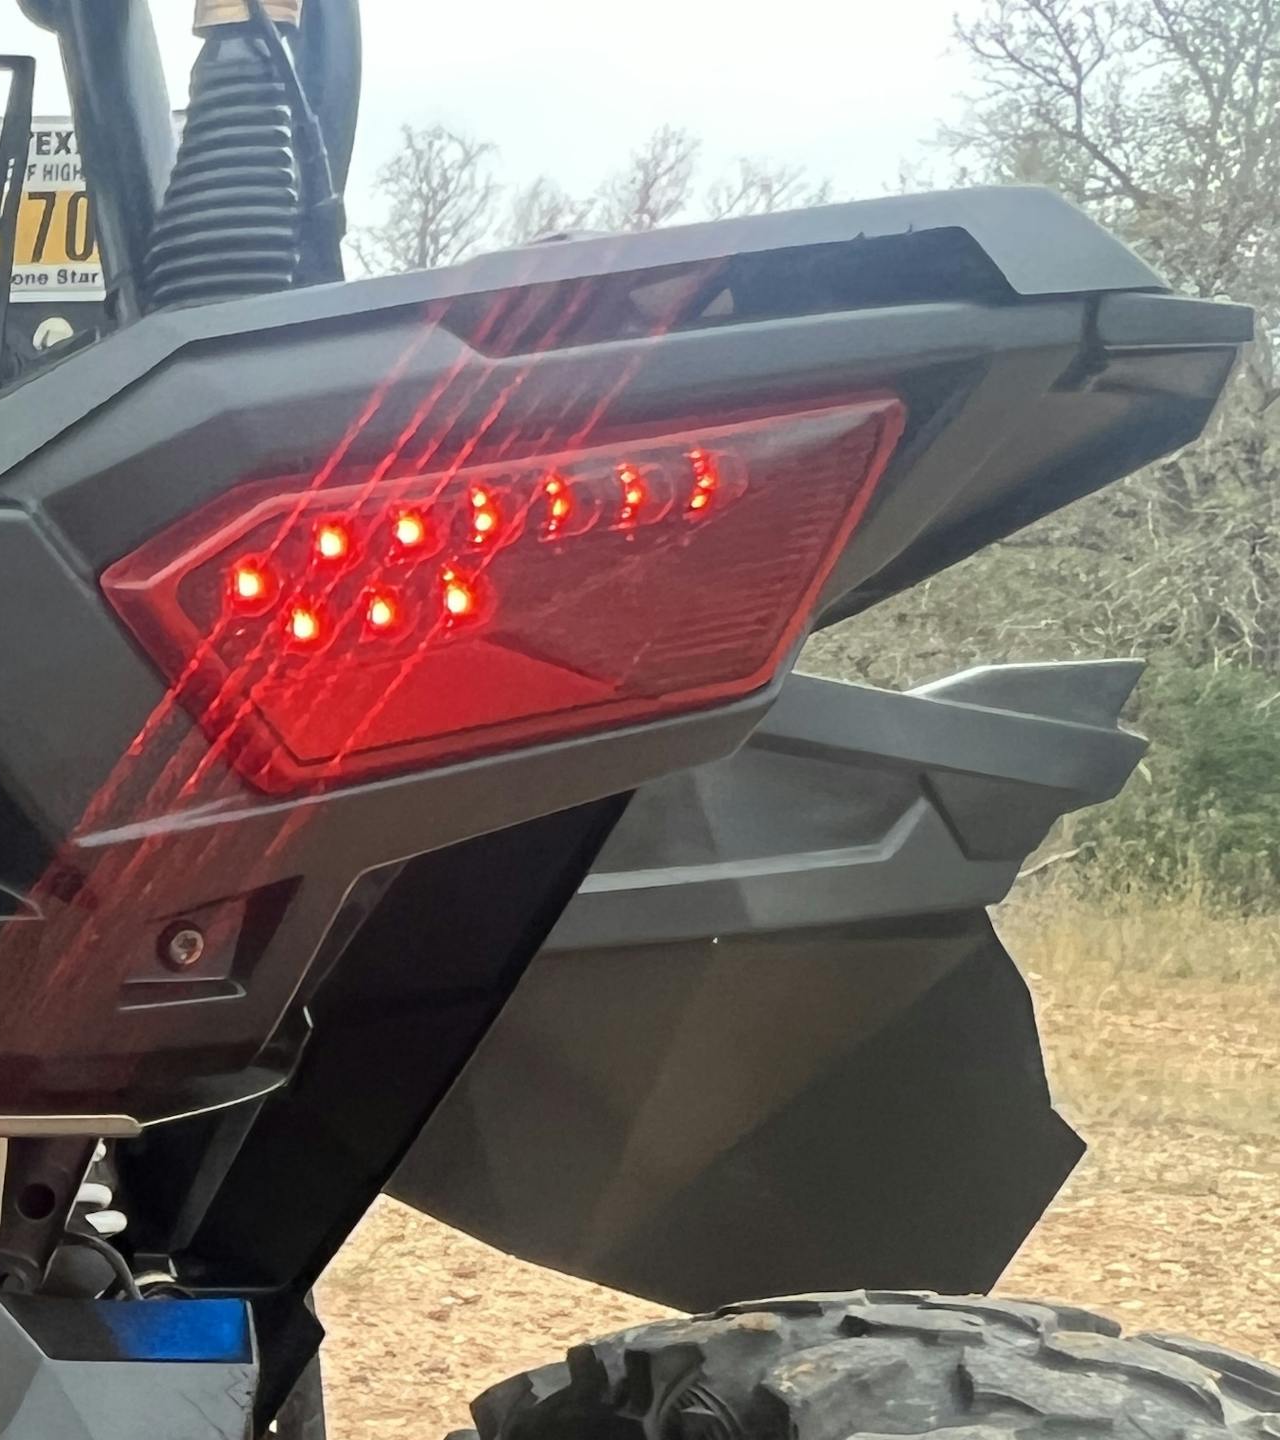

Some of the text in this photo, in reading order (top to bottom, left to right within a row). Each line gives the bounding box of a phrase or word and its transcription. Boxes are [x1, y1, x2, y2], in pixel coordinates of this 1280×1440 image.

[30, 131, 81, 155] EX
[9, 268, 99, 286] one Star
